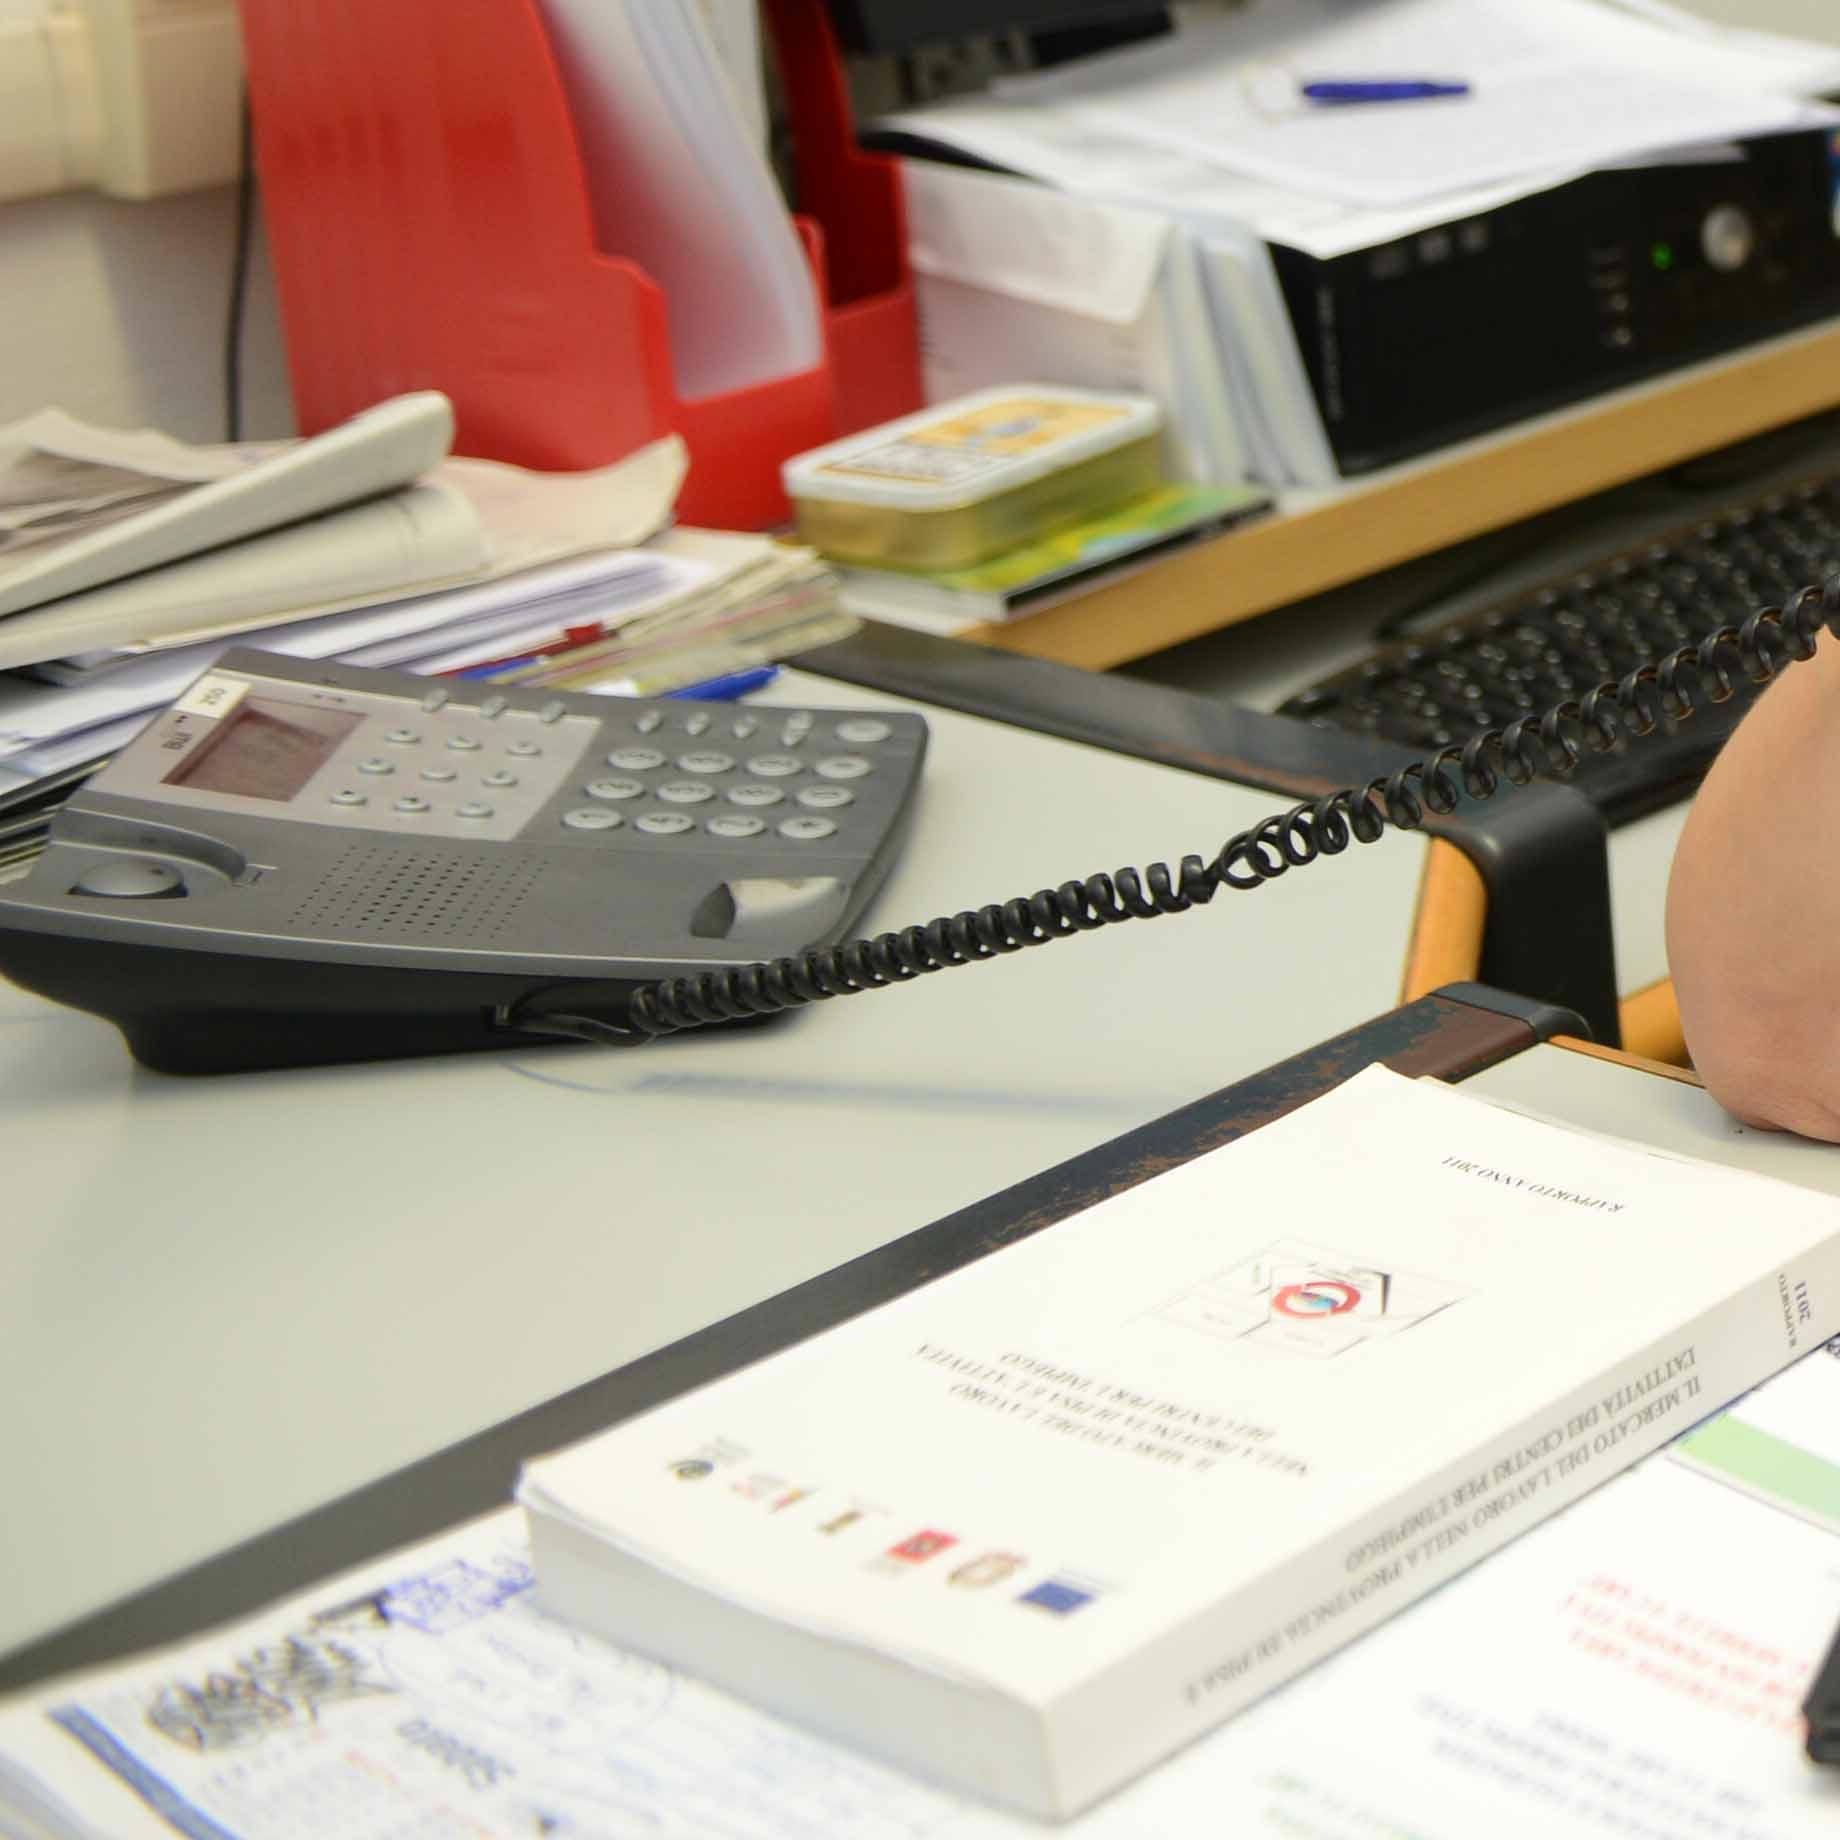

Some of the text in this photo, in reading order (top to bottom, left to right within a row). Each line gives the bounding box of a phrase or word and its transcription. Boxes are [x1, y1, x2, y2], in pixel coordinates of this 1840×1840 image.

[1442, 1155, 1479, 1173] 2011
[1528, 1183, 1625, 1213] RAPPORTO
[1794, 1280, 1811, 1325] 2011
[1683, 1375, 1702, 1401] IL
[1566, 1403, 1600, 1441] DEI
[1593, 1387, 1681, 1454] MERCATO
[1492, 1427, 1564, 1485] CENTRI
[1556, 1443, 1590, 1479] DEL
[1452, 1472, 1489, 1508] PER
[1472, 1466, 1553, 1529] LAVORO
[1406, 1520, 1470, 1568] NELLA
[1285, 1563, 1402, 1642] PROVINCIA
